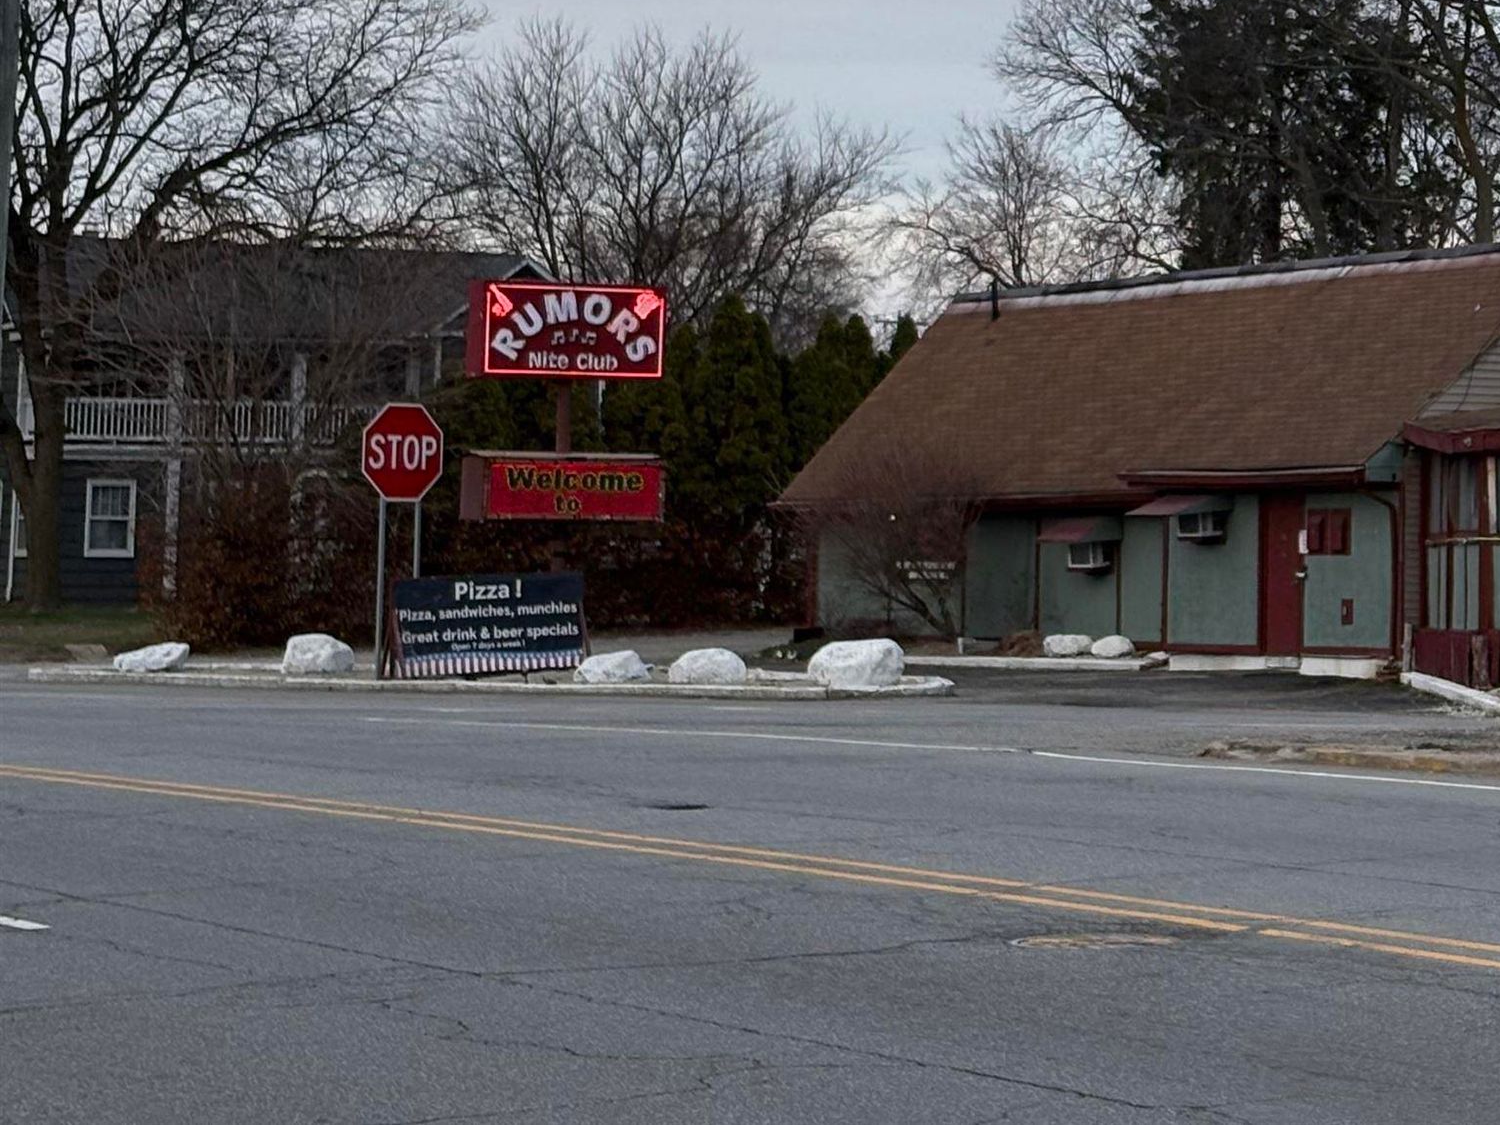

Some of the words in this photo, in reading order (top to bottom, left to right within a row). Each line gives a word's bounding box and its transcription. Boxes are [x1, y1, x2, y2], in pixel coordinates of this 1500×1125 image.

[491, 290, 658, 363] RUMORS
[528, 352, 569, 370] Nite
[576, 352, 619, 371] Club
[368, 433, 438, 471] STOP
[506, 466, 645, 492] Welcome
[554, 494, 582, 513] to
[454, 580, 511, 601] Pizza
[399, 608, 437, 623] Pizza,
[438, 604, 515, 619] sandwiches,
[517, 600, 578, 616] munchies
[402, 631, 439, 645] Great
[442, 627, 477, 642] drink
[480, 626, 491, 640] &
[494, 625, 524, 639] beer
[527, 622, 580, 640] specials
